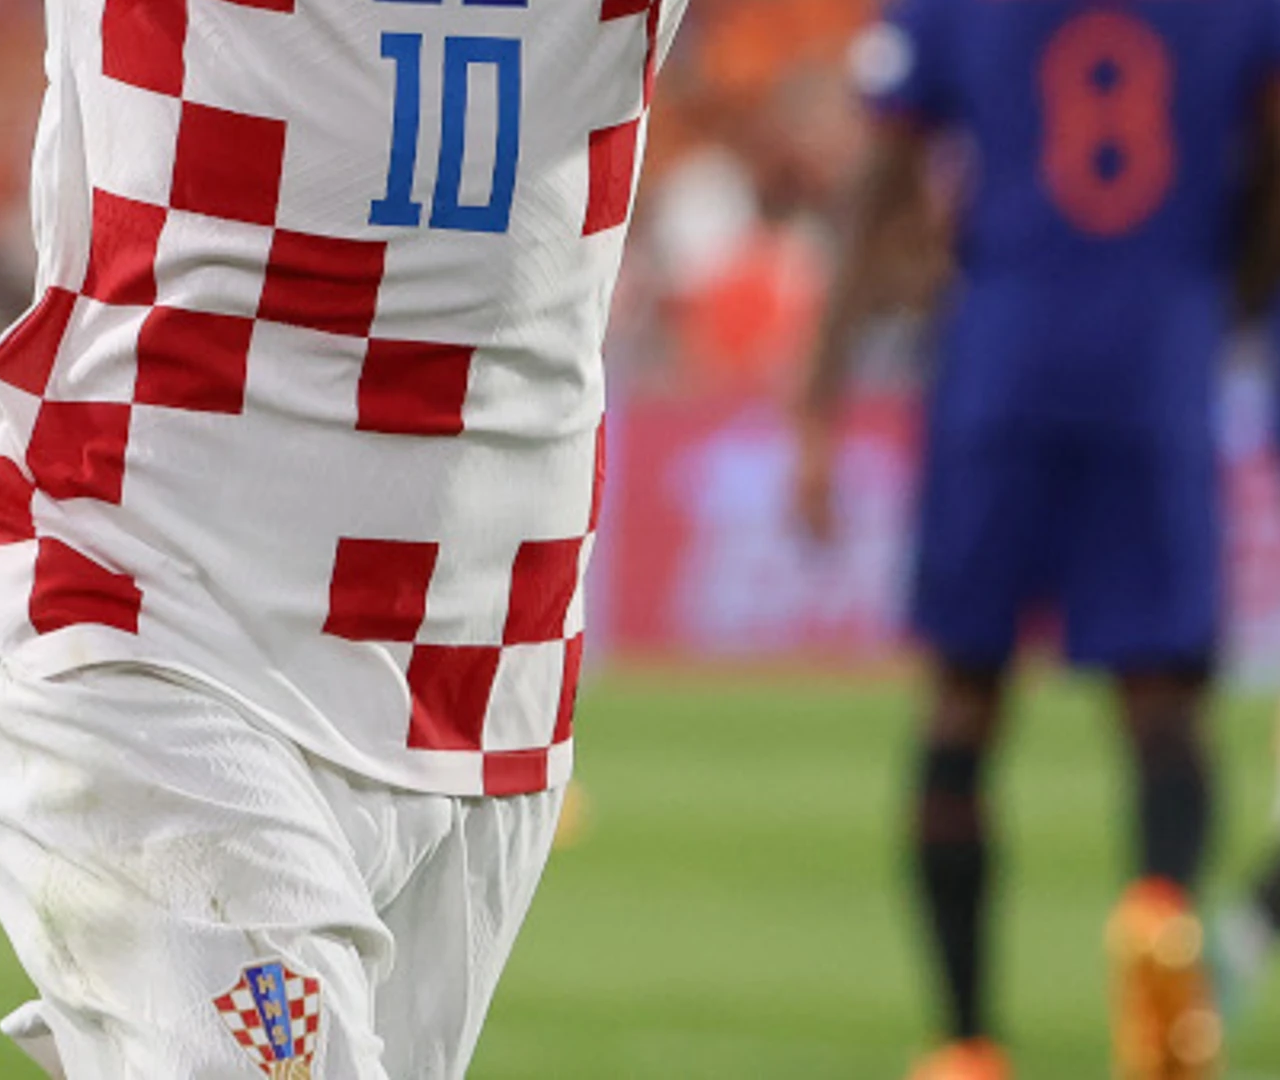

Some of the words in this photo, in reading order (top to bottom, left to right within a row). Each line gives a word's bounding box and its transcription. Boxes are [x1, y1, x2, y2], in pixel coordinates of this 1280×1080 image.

[368, 31, 522, 234] 10
[1041, 10, 1176, 237] 8
[256, 973, 288, 1046] HNS
